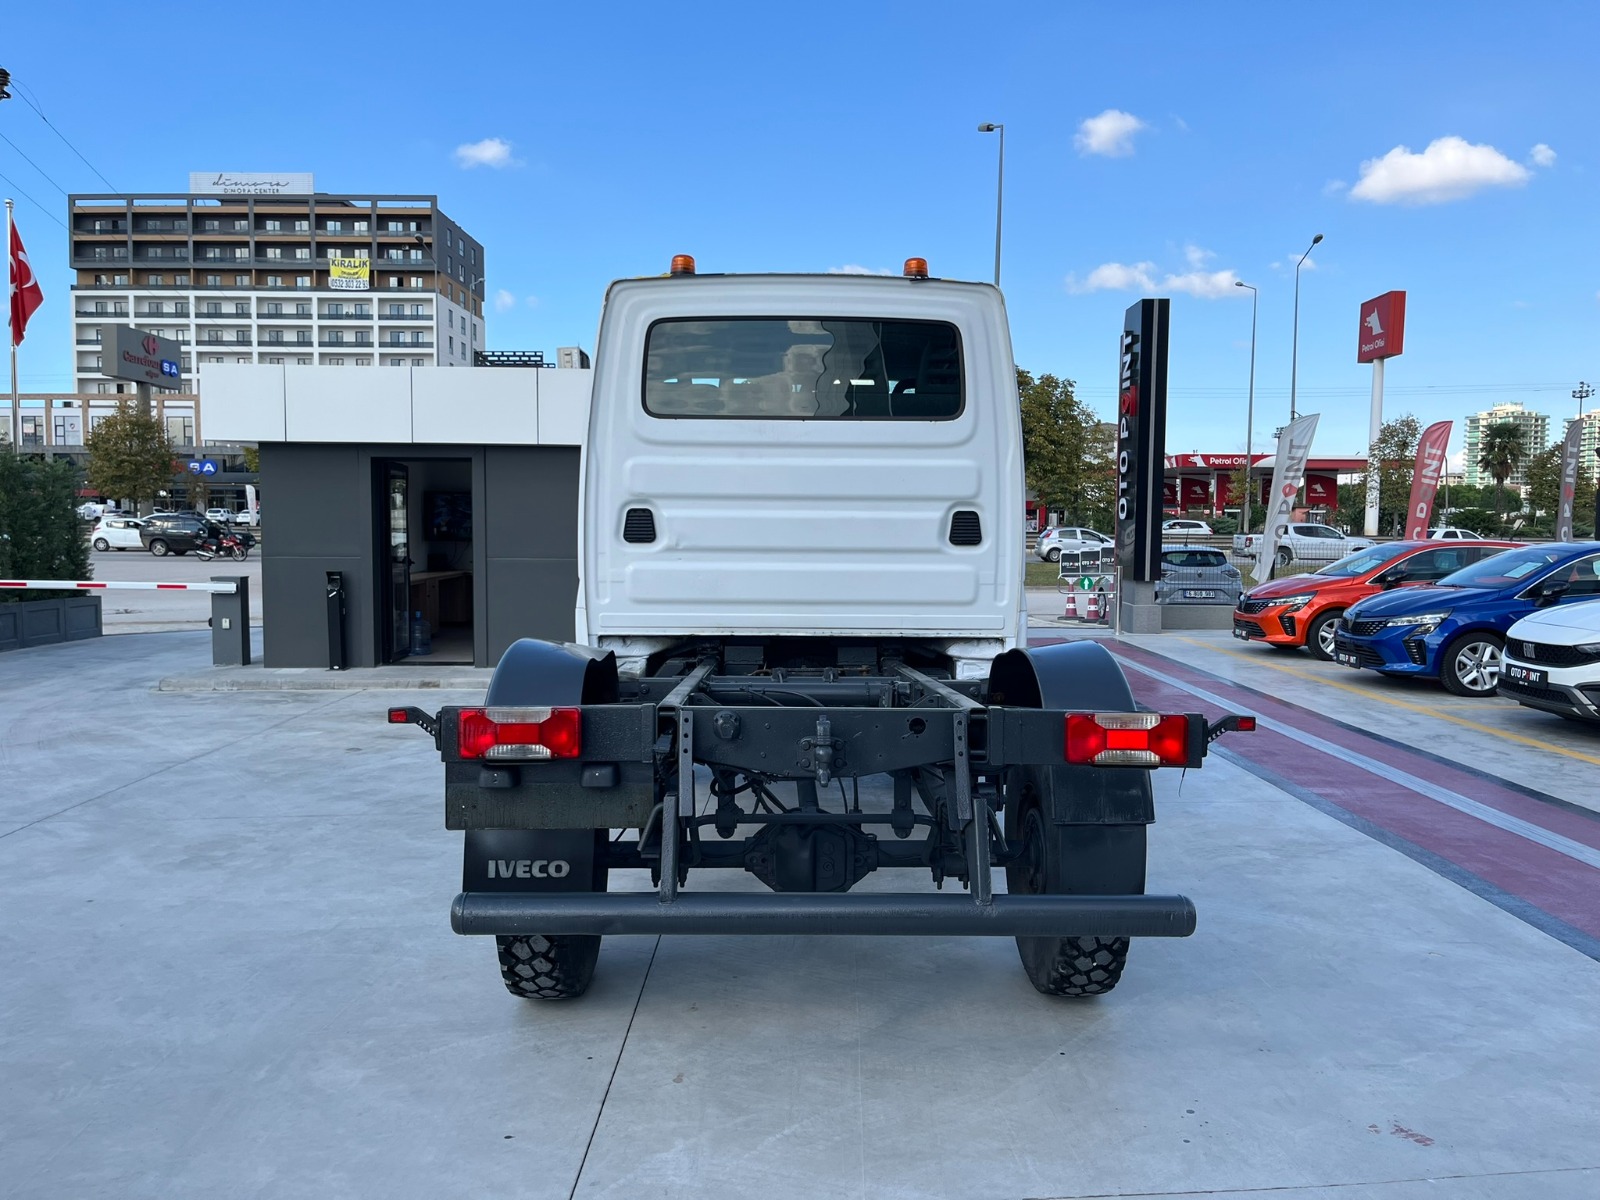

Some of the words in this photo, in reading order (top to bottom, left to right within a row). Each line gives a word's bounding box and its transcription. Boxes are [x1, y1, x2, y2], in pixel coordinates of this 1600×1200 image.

[1209, 457, 1232, 465] Petrol
[1119, 450, 1129, 520] OTO
[1511, 667, 1521, 678] OTO
[487, 860, 570, 878] IVECO
